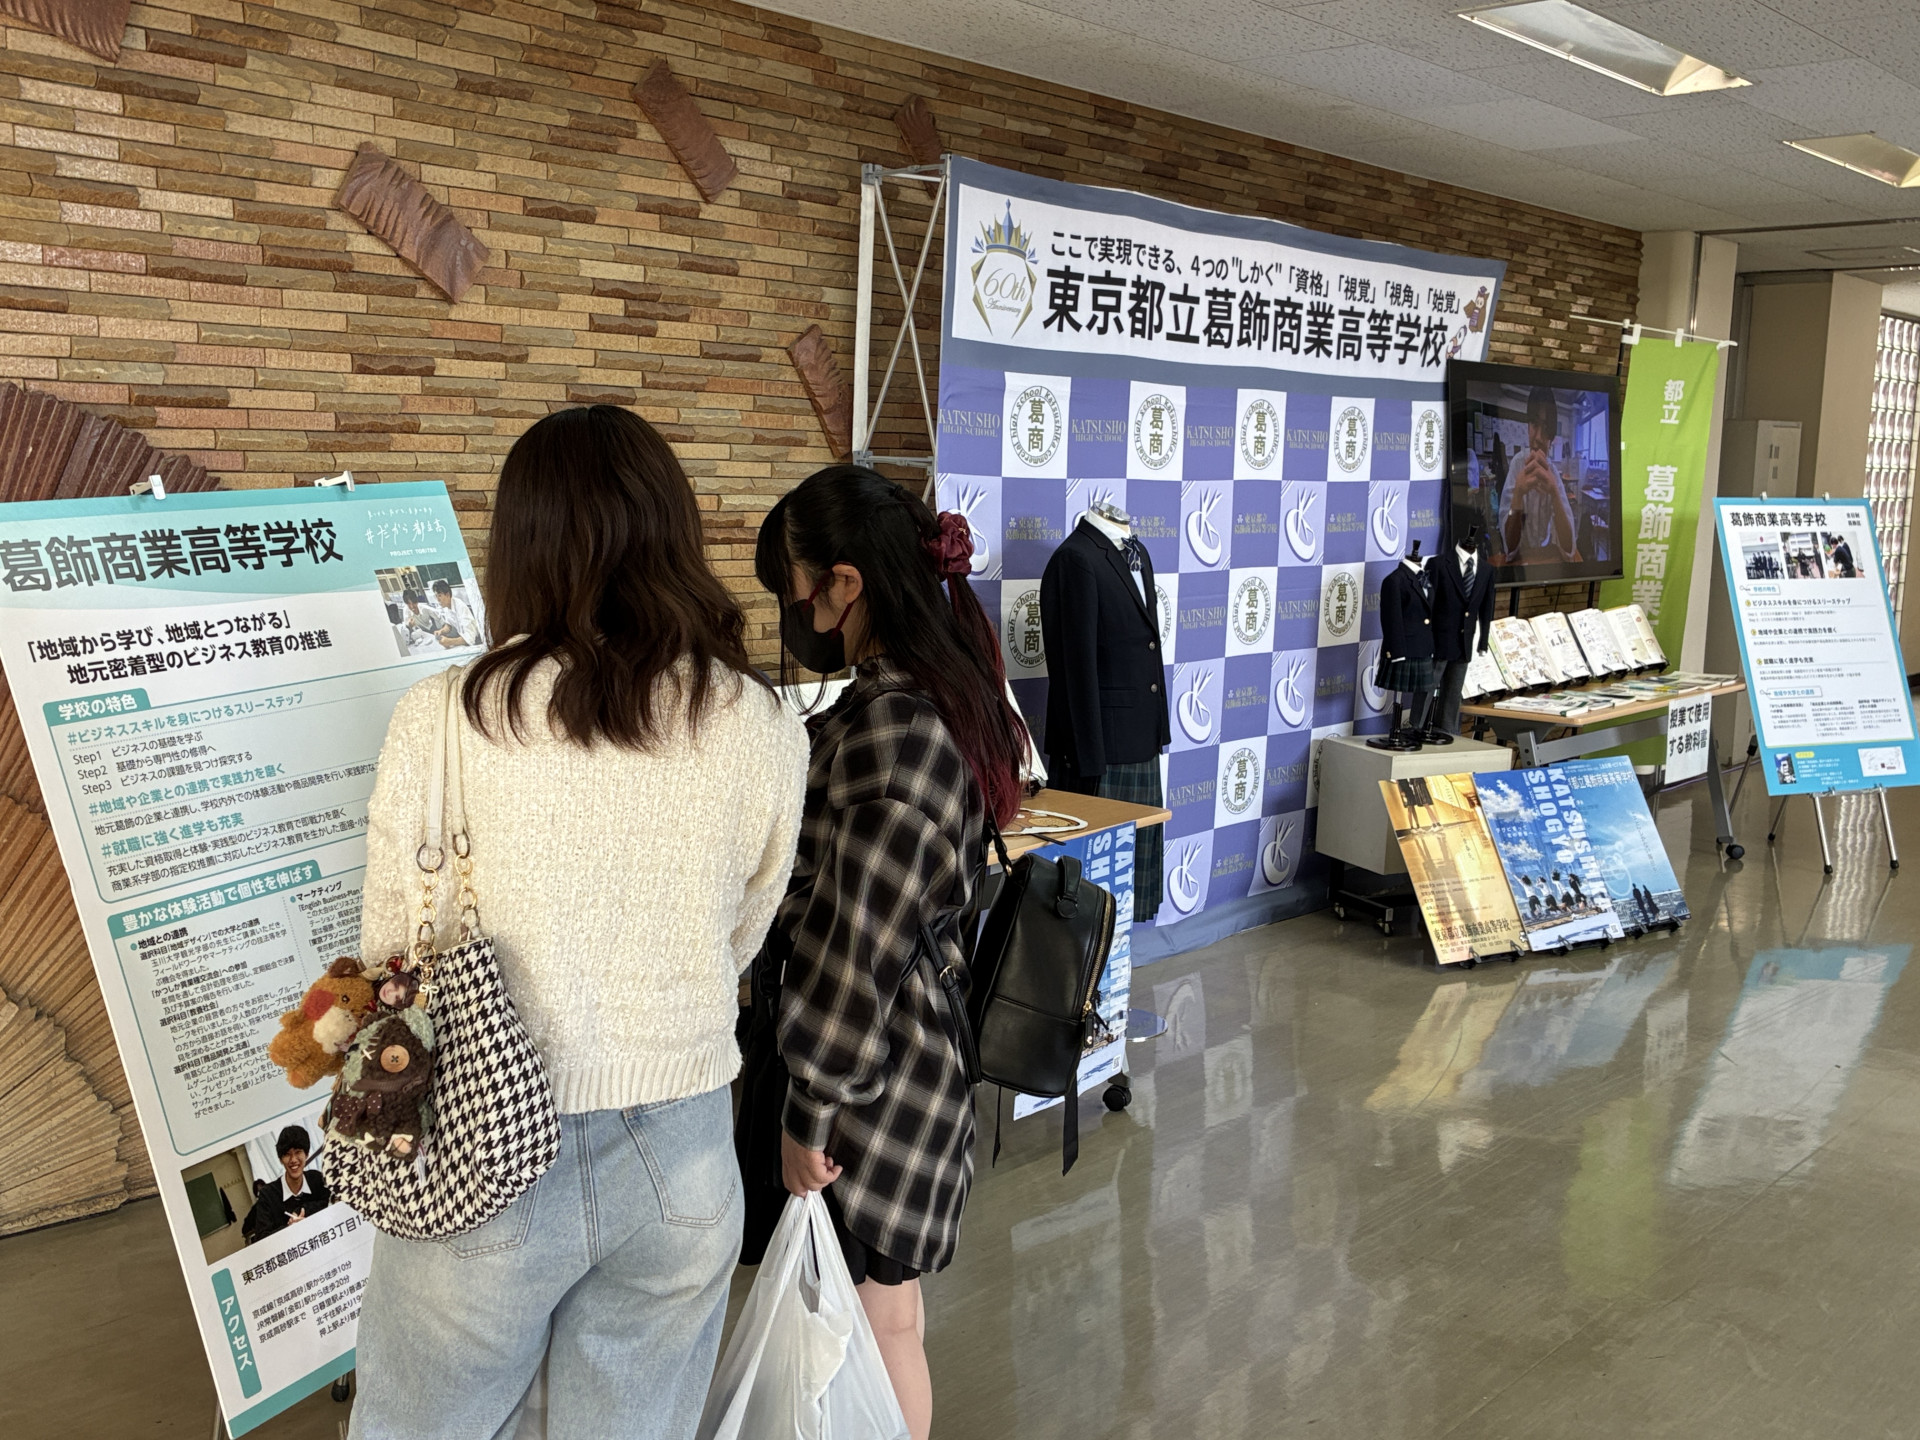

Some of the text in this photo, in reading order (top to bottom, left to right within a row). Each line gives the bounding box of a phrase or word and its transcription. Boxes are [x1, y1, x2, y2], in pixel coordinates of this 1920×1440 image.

[984, 268, 1028, 302] 60th
[1043, 265, 1448, 368] 東京都立葛飾商業高等学校
[939, 409, 1000, 428] KATSUSHO
[1016, 386, 1042, 410] school
[1660, 379, 1684, 424] 都立
[943, 425, 998, 437] HIGH SCHOOL
[1028, 398, 1045, 452] 葛商
[1045, 390, 1061, 449] katsushika
[1071, 419, 1126, 434] KATSUSHO
[1149, 405, 1164, 456] 葛商
[1187, 425, 1234, 439] KATSUSHO
[1254, 410, 1267, 457] 葛商
[1286, 429, 1328, 443] KATSUSHO
[1345, 417, 1357, 461] 葛商
[1374, 431, 1409, 445] KATSUSHO
[1424, 420, 1434, 460] 葛商
[1730, 512, 1828, 527] 葛飾商業高等学校
[1, 518, 344, 592] 葛飾商業高等学校
[1014, 590, 1037, 615] school
[1180, 606, 1225, 622] KATSUSHO
[1245, 587, 1259, 633] 葛商
[1278, 599, 1318, 613] KATSUSHO
[1335, 582, 1348, 625] 葛商
[28, 609, 292, 663] 「地域から学び、地域とつながる」
[1024, 602, 1041, 654] 葛商
[67, 629, 333, 685] 地元密着型のビジネス教育の推進
[58, 693, 138, 720] 学校の特色
[68, 691, 304, 745] #ビジネススキルを身につけるスリーステップ
[1669, 702, 1709, 729] 授業で使用
[73, 731, 204, 766] Step1 ビジネスの基礎を学ぶ
[78, 747, 216, 781] Step2 基礎から専門性の修得へ
[1669, 730, 1707, 757] する教科書
[82, 751, 253, 796] Step3 ビジネスの課題を見つけ探究する
[89, 763, 286, 816] #地域や企業との連携で実践力を磨く
[1170, 779, 1215, 800] KATSUSHO
[1234, 758, 1249, 804] 葛商
[1267, 763, 1307, 781] KATSUSHO
[95, 761, 379, 836] 地元葛飾の企業と連携し、学校内外での体験活動や商品開発を行い実践的な
[1528, 769, 1575, 864] SHOGYO
[101, 812, 244, 860] #就職に強く進学も充実
[122, 864, 314, 932] 豊かな体験活動で個性を伸ばす
[296, 881, 343, 901] マーケティング
[137, 927, 189, 950] 地域との連携
[221, 1295, 252, 1371] アクセス
